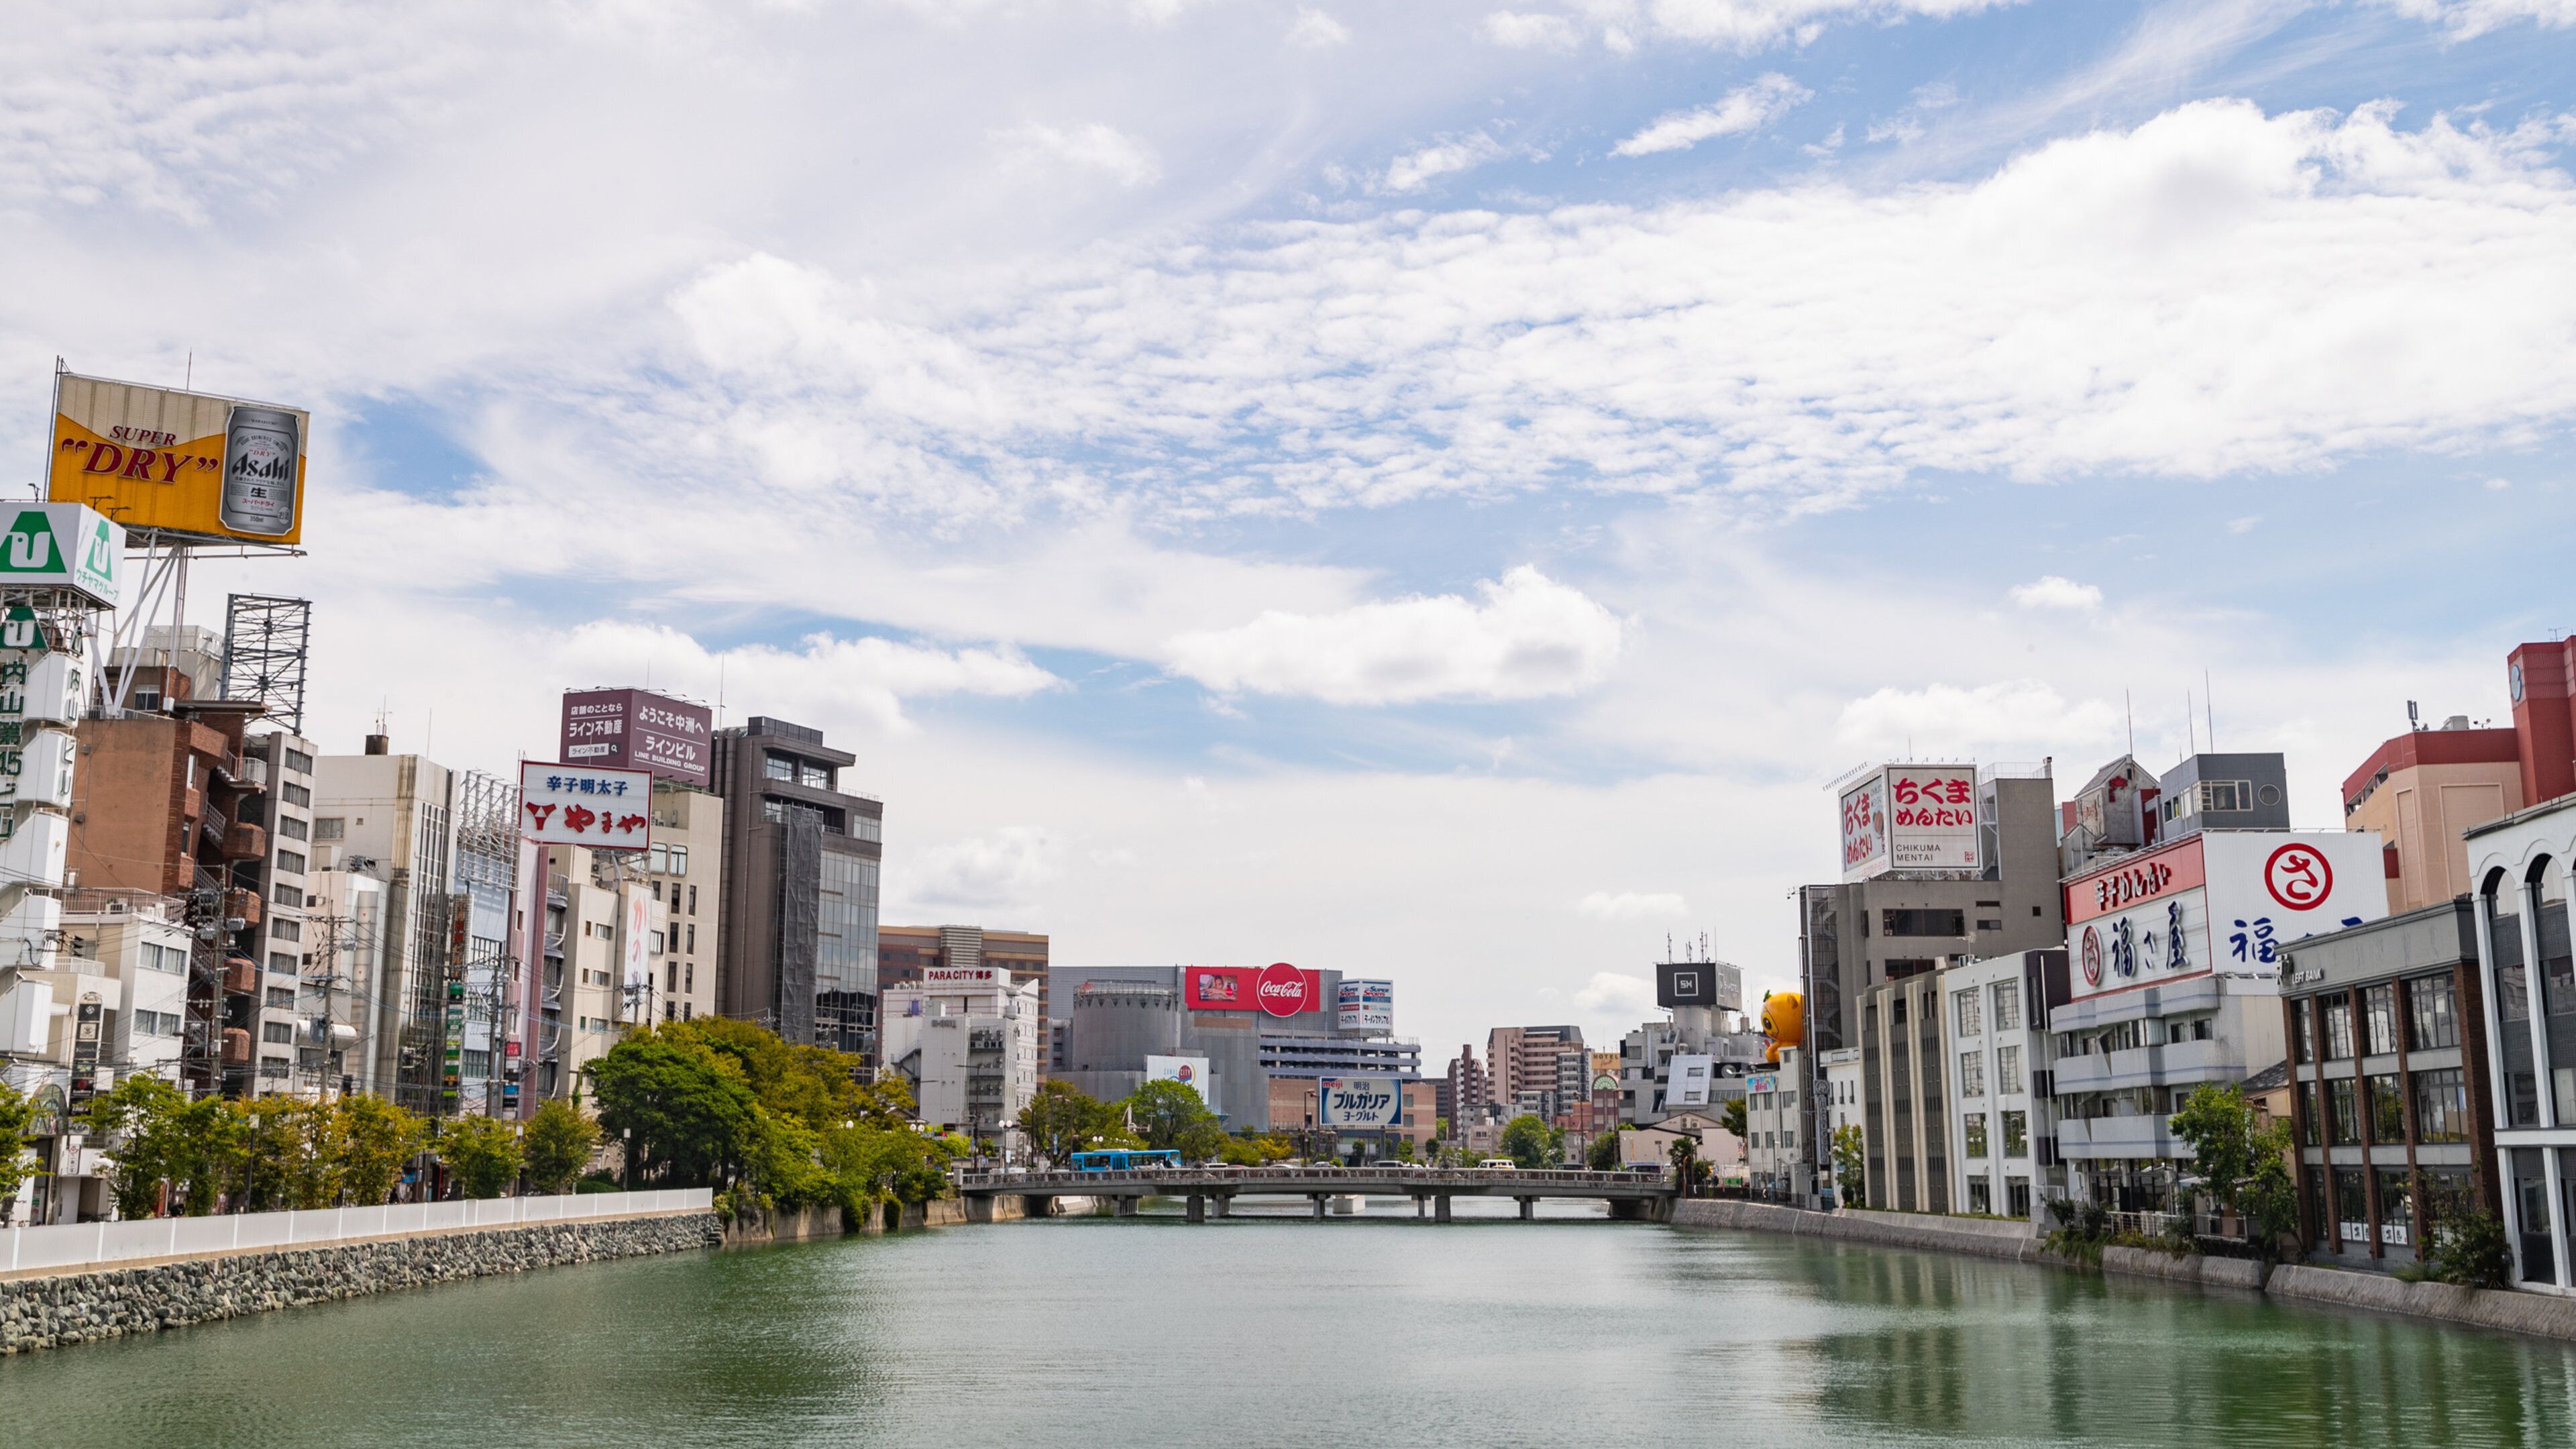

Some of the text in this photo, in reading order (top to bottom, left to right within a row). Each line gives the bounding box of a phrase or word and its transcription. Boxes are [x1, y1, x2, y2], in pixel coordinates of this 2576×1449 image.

[109, 425, 177, 446] SUPER
[231, 452, 290, 482] Asahi
[251, 487, 267, 498] 生
[76, 568, 119, 600] ウチヤマグループ
[570, 702, 623, 716] 店舗のことなら
[569, 718, 623, 737] ライン不動産
[639, 705, 704, 734] ようこそ中洲へ
[645, 735, 696, 761] ラインビル
[634, 751, 705, 772] LINE BUILDING GROUP
[547, 775, 629, 797] 辛子明太子
[1892, 777, 1971, 804] ちくま
[564, 803, 646, 835] やまや
[1844, 792, 1871, 835] ちくま
[1896, 807, 1973, 826] めんたい
[1846, 833, 1873, 865] めんたい
[1896, 844, 1941, 852] CHIKUMA
[1896, 853, 1933, 861] MENTAI
[975, 970, 992, 979] 博多
[2292, 967, 2322, 985] LEFT BANK
[1260, 980, 1305, 998] Coca-Cola
[1323, 1079, 1343, 1089] meiji
[1353, 1081, 1370, 1091] 明治
[1334, 1091, 1391, 1110] ブルガリア
[1343, 1110, 1379, 1122] ヨーグルト
